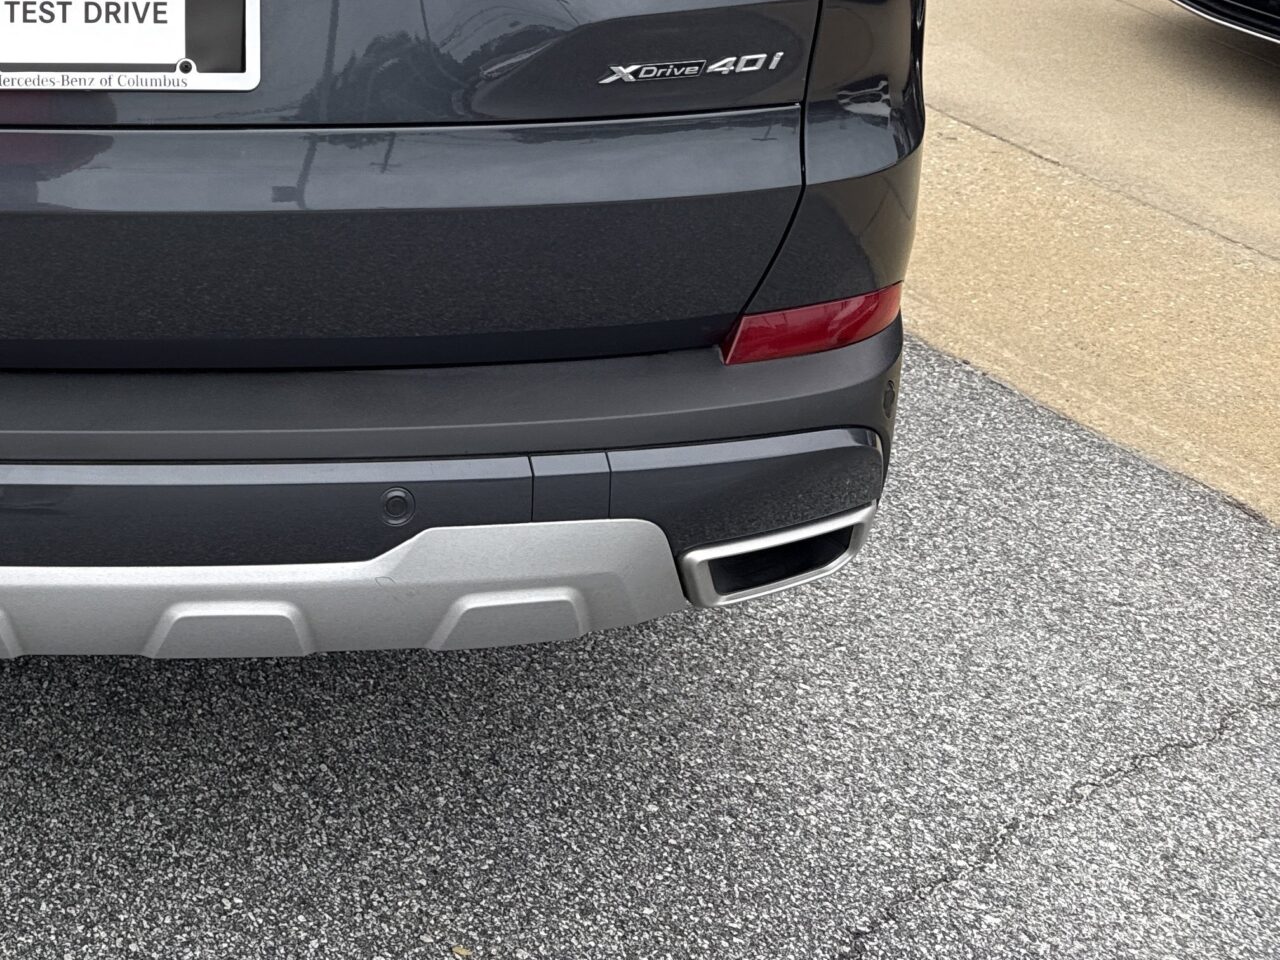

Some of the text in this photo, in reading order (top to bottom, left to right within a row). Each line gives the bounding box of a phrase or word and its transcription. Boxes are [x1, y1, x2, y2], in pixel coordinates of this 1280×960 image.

[4, 0, 169, 25] TEST DRIVE
[99, 73, 113, 87] of
[117, 74, 188, 88] Columbus
